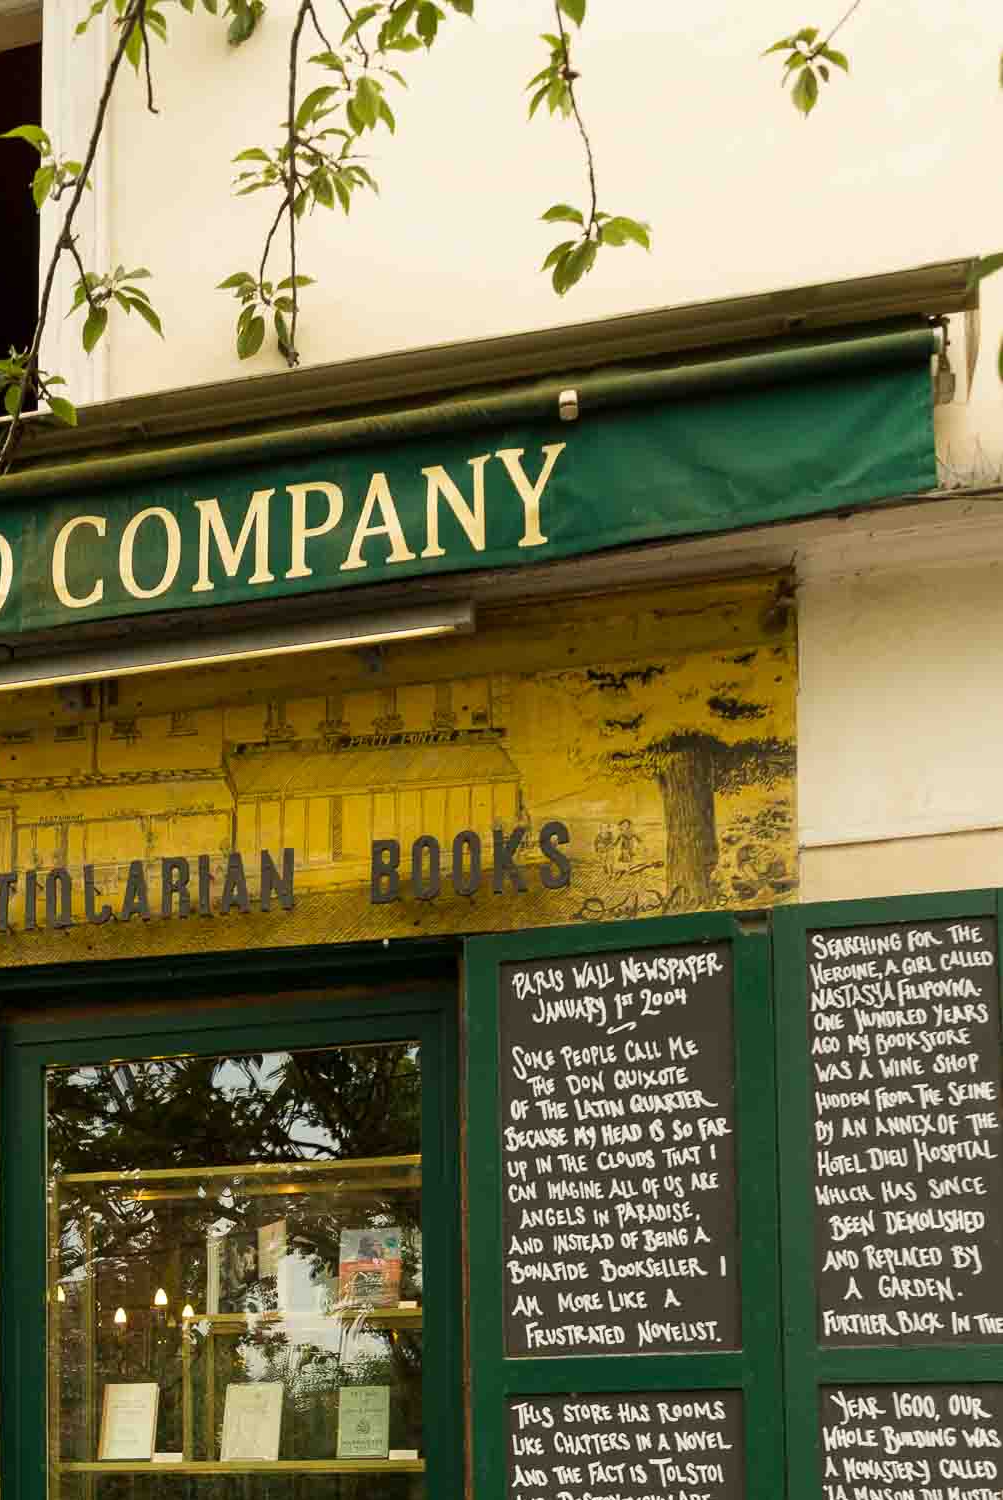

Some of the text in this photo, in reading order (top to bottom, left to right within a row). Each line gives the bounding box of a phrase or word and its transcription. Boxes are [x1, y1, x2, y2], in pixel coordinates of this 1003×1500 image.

[51, 441, 567, 609] COMPANY
[370, 820, 572, 905] BOOKS
[811, 924, 983, 961] SEARCHING FOR THE
[511, 952, 724, 1001] PARIS WALL NEWSPAPER
[884, 959, 901, 977] A
[901, 955, 938, 976] GIRL
[939, 950, 994, 972] CALLED
[531, 995, 607, 1027] JANUARY
[639, 987, 687, 1016] 2004
[810, 980, 897, 1012] NASTASYA
[813, 1003, 989, 1035] ONE HUNDRED YEARS
[511, 1035, 699, 1081] SOME PEOPLE CALL ME
[526, 1065, 689, 1098] THE DON QUIXOTE
[510, 1089, 719, 1121] OF THE LATIN QUARTER
[816, 1137, 999, 1177] HOTEL DIEU HOSPITAL
[519, 1205, 587, 1230] ANGELS
[592, 1209, 610, 1228] IN
[828, 1207, 985, 1242] BEEN DEMOLISHED
[508, 1225, 711, 1256] AND INSTEAD OF BEING A
[506, 1255, 727, 1285] BONAFIDE BOOKSELLER I
[511, 1287, 682, 1318] AM MORE LIKE A
[843, 1274, 964, 1303] A GARDEN.
[525, 1319, 722, 1349] FRUSTRATED NOVELIST.
[510, 1400, 727, 1430] THIS STORE HAS ROOMS
[829, 1390, 887, 1426] YEAR
[948, 1393, 993, 1421] OUR
[511, 1430, 733, 1456] LIKE CHAPTERS IN A NOVEL
[511, 1457, 725, 1488] AND THE FACT IS TOLSTOI
[824, 1455, 998, 1486] A MONASTERY CALLED
